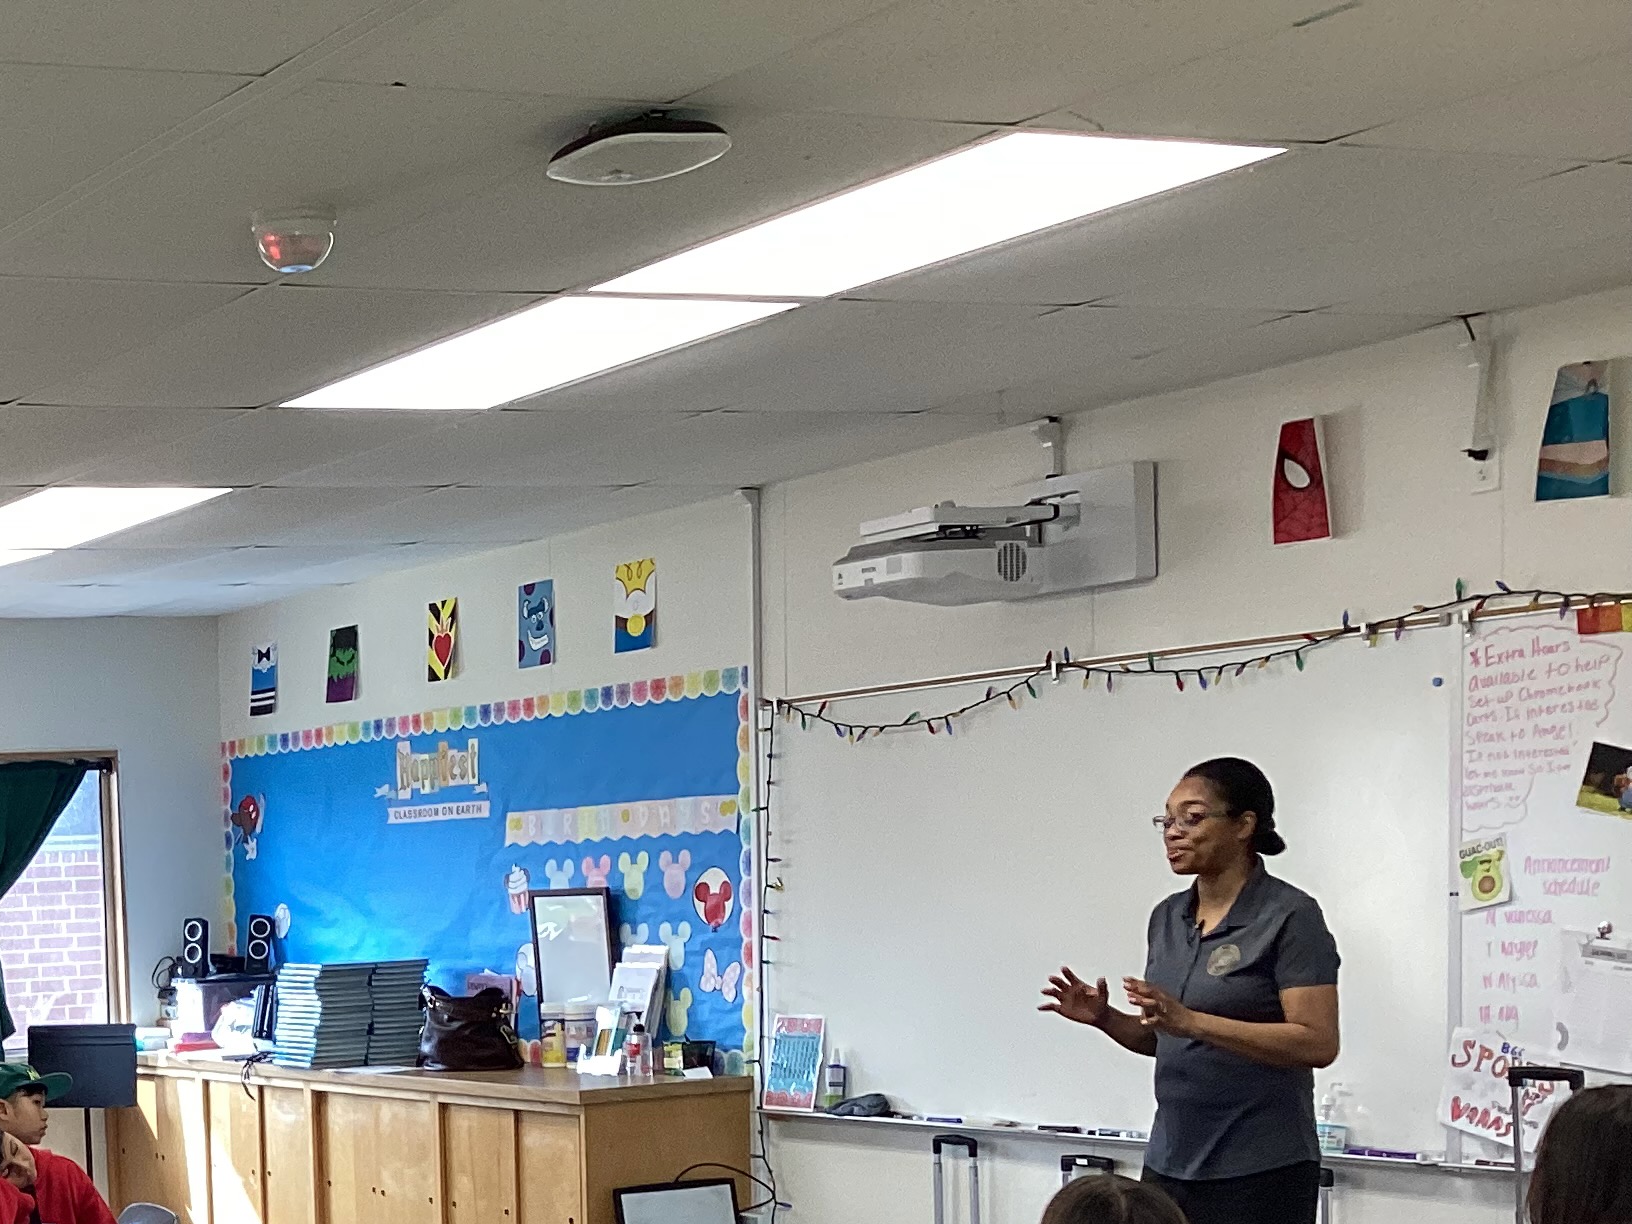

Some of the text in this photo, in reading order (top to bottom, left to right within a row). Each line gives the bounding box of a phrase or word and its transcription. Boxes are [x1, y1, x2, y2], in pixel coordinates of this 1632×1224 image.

[1545, 662, 1570, 680] to
[397, 743, 477, 791] Happiest
[394, 804, 482, 820] CLASSROOM ON EARTH
